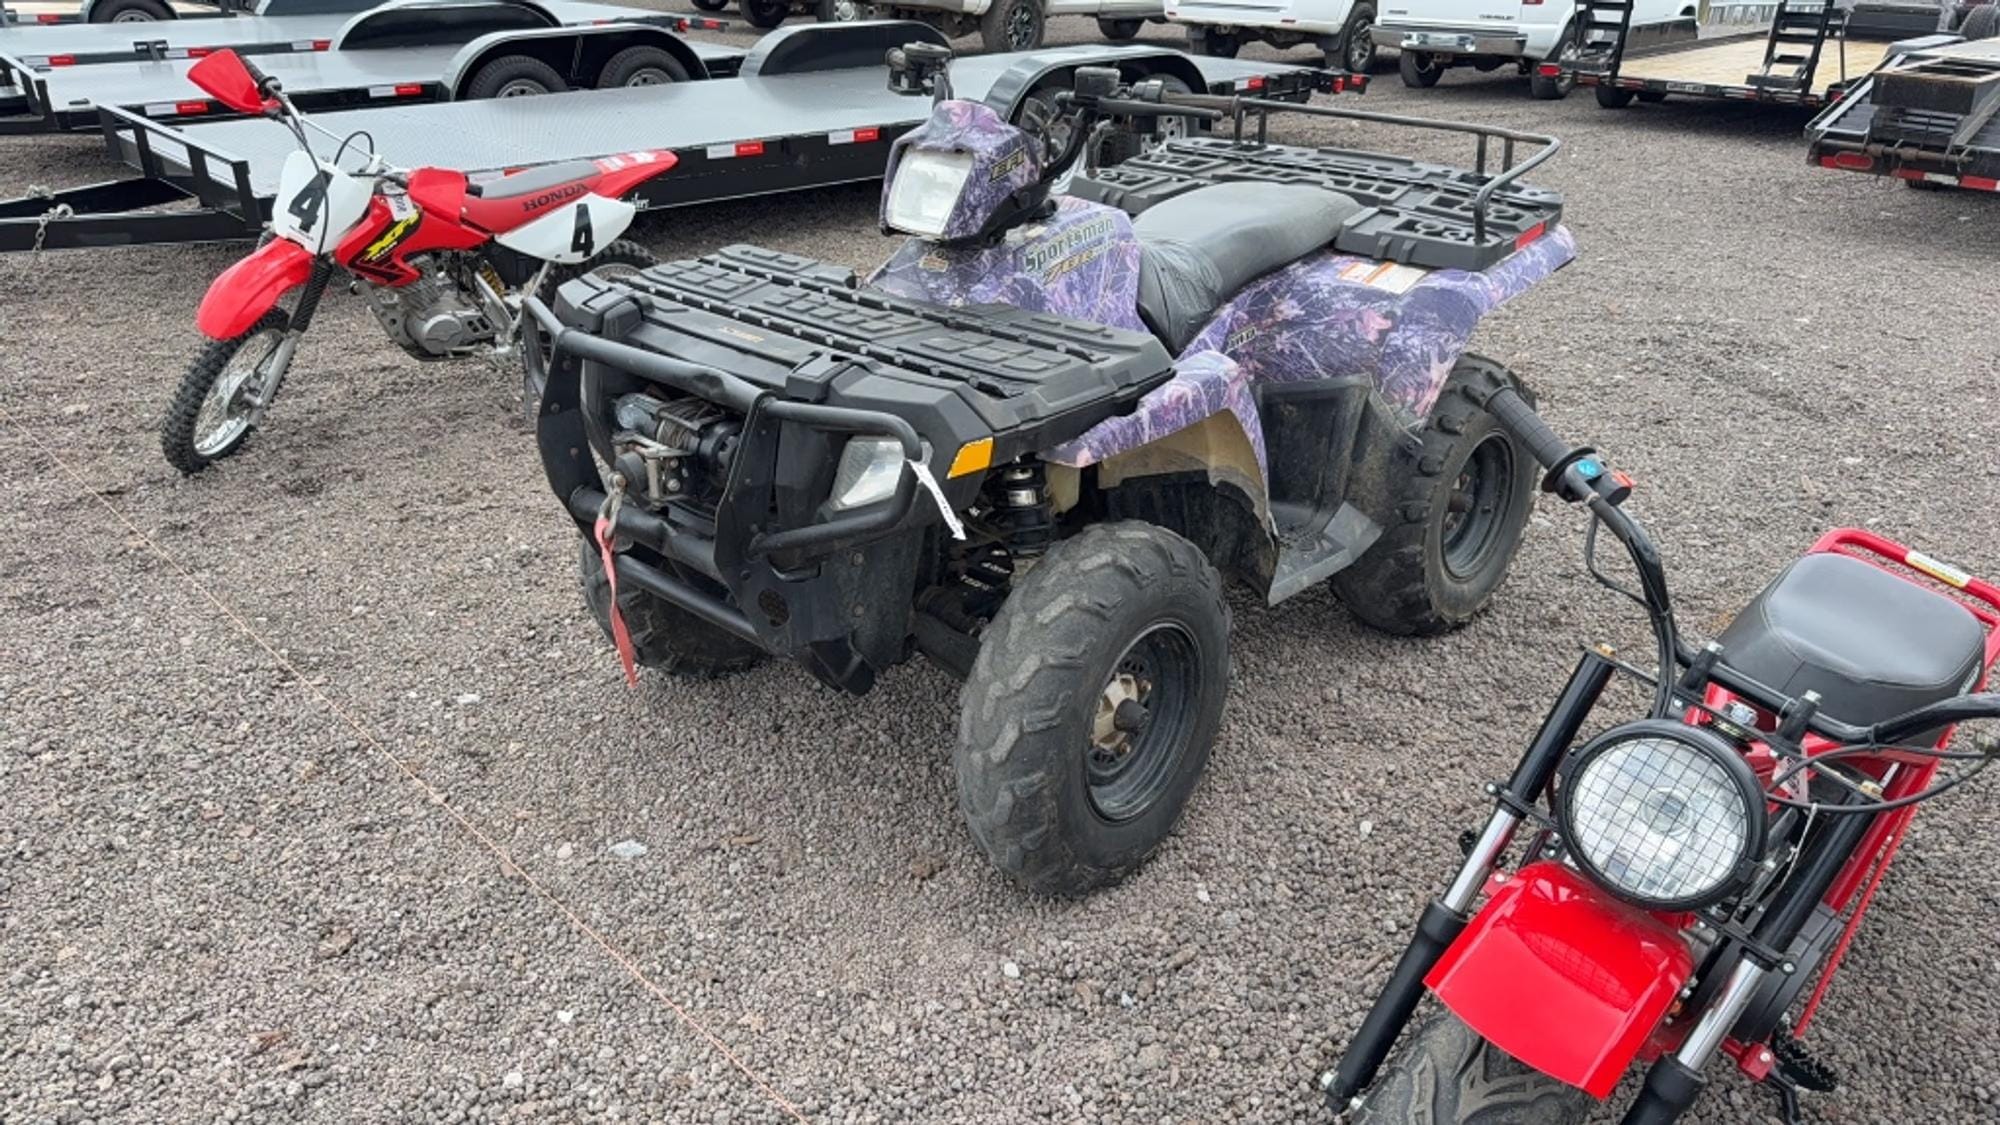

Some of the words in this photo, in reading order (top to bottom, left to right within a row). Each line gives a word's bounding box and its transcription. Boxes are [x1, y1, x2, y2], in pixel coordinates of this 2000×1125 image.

[989, 147, 1025, 184] EFI
[287, 169, 334, 233] 4
[523, 184, 588, 211] HONDA
[571, 204, 595, 258] 4
[1024, 215, 1115, 273] Sportsman
